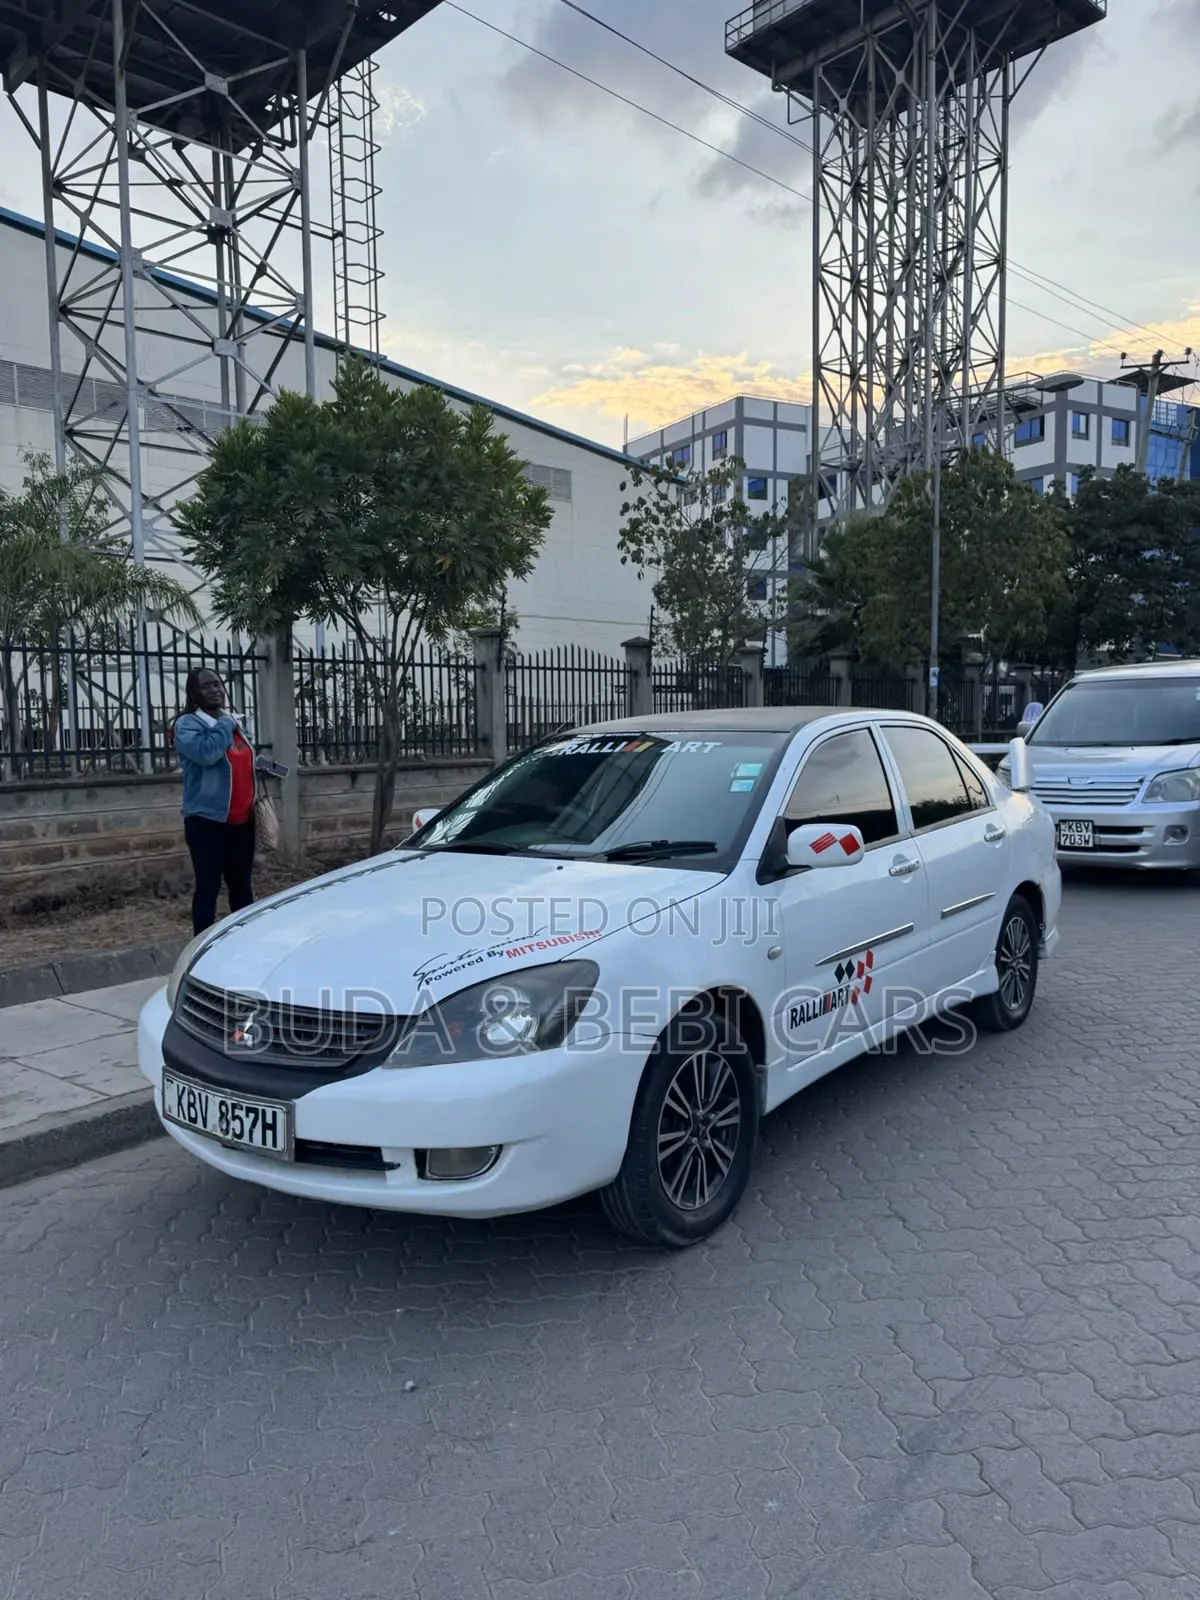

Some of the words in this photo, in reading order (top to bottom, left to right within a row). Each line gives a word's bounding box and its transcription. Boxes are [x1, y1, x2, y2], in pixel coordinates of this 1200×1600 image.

[661, 741, 723, 754] ART
[1067, 822, 1090, 833] KBY
[1062, 834, 1090, 846] 703W
[424, 955, 484, 985] Powered
[487, 949, 505, 959] By
[505, 929, 602, 959] MITSUBISHI
[176, 1083, 209, 1129] KBV
[218, 1099, 278, 1149] 857H
